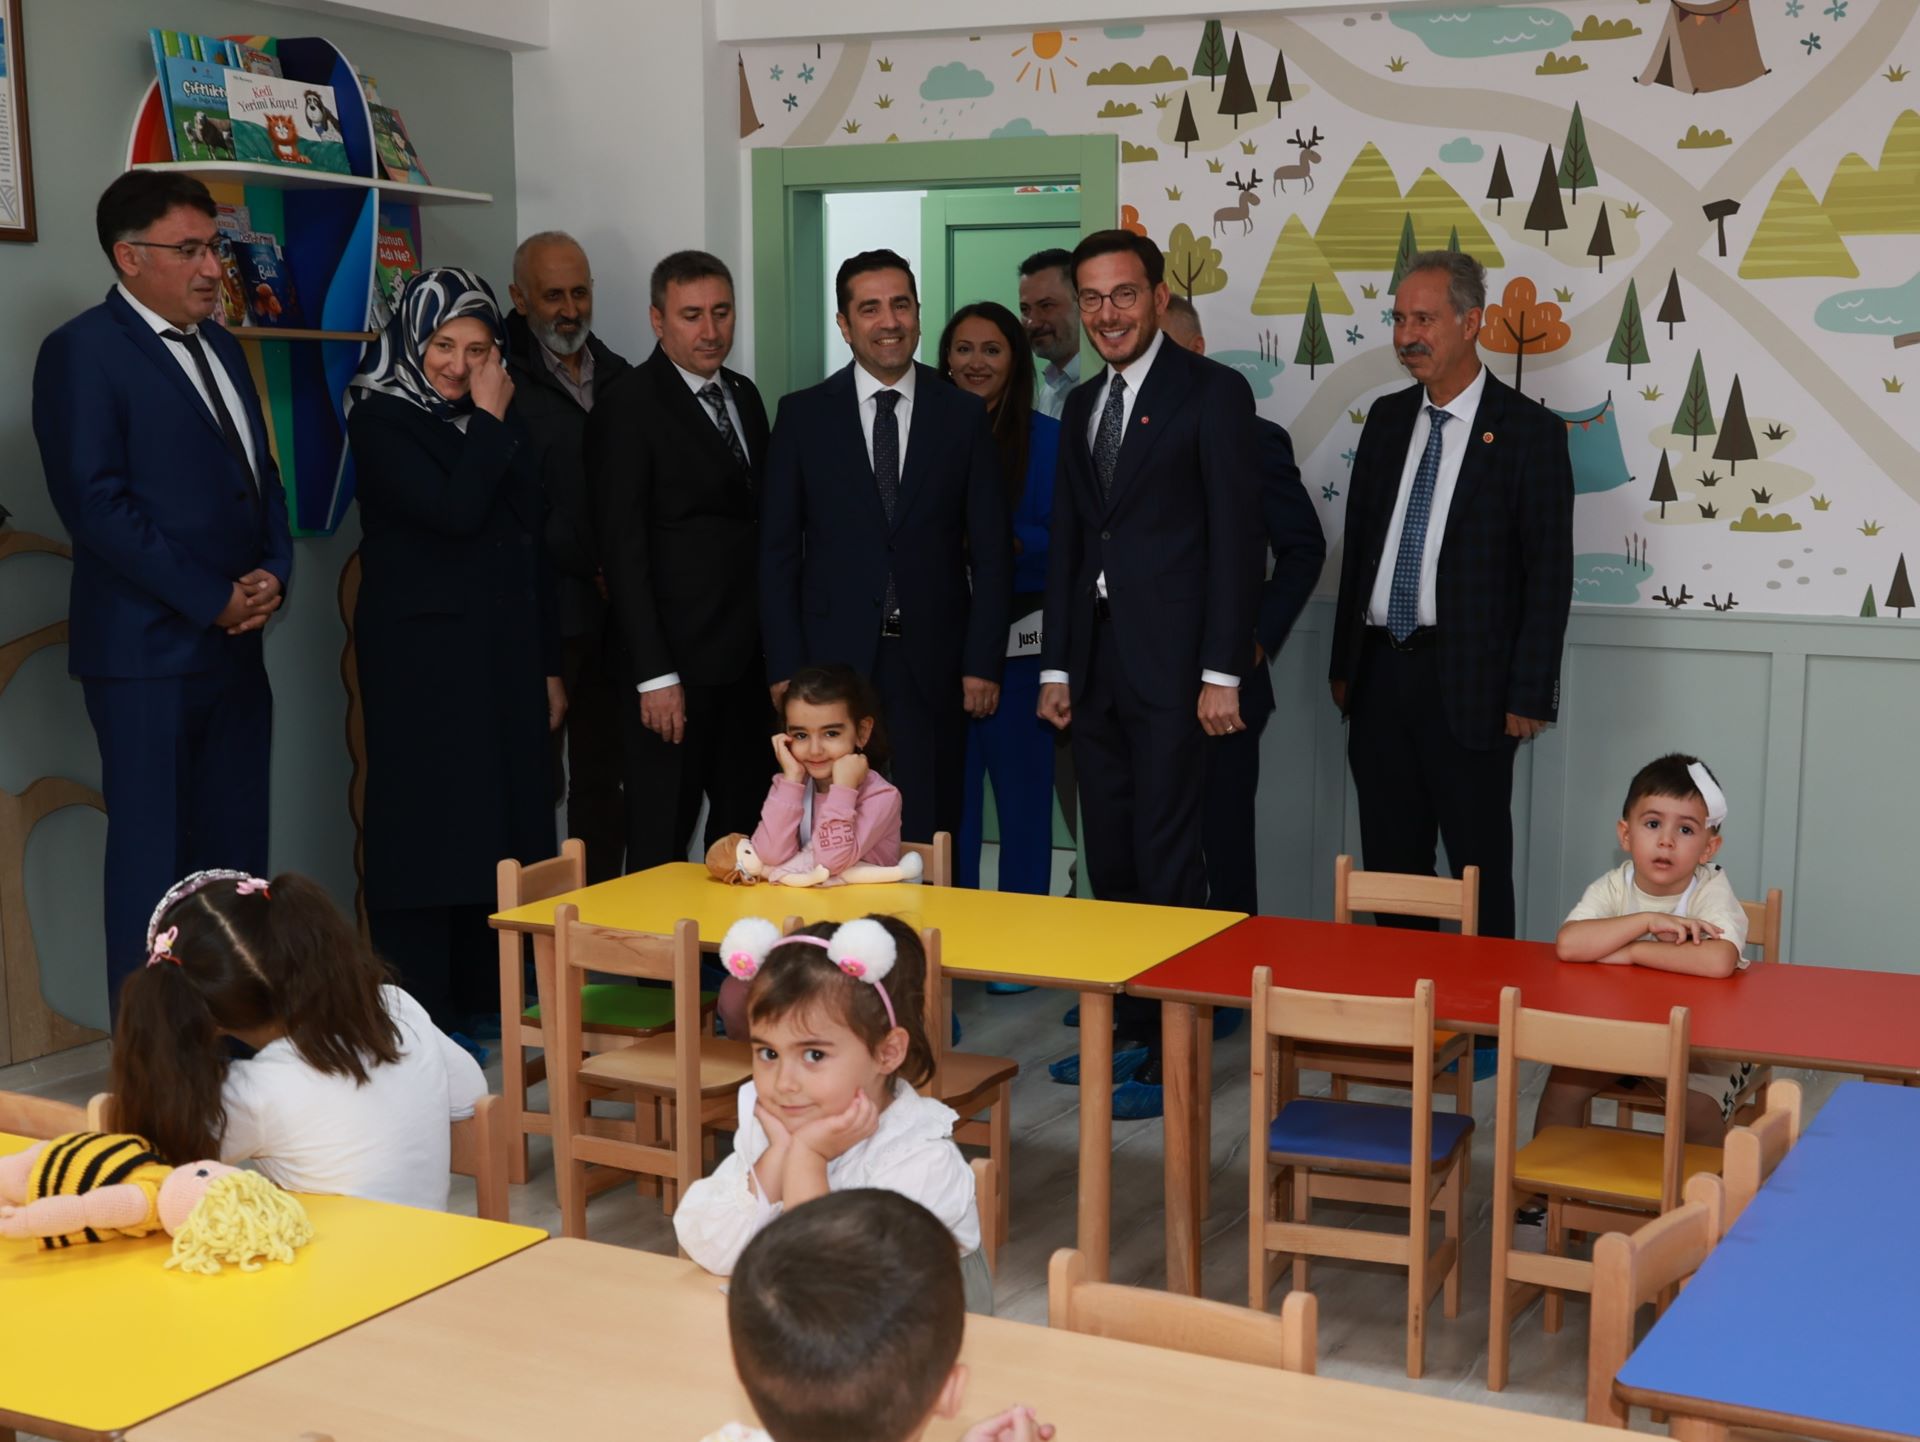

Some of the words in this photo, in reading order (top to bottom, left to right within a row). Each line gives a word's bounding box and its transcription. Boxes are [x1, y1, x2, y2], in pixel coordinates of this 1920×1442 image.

[251, 85, 273, 98] Kedi
[237, 99, 268, 112] Yerimi
[268, 97, 298, 111] Kaptı!
[380, 247, 394, 261] Adı
[393, 250, 411, 263] Ne?
